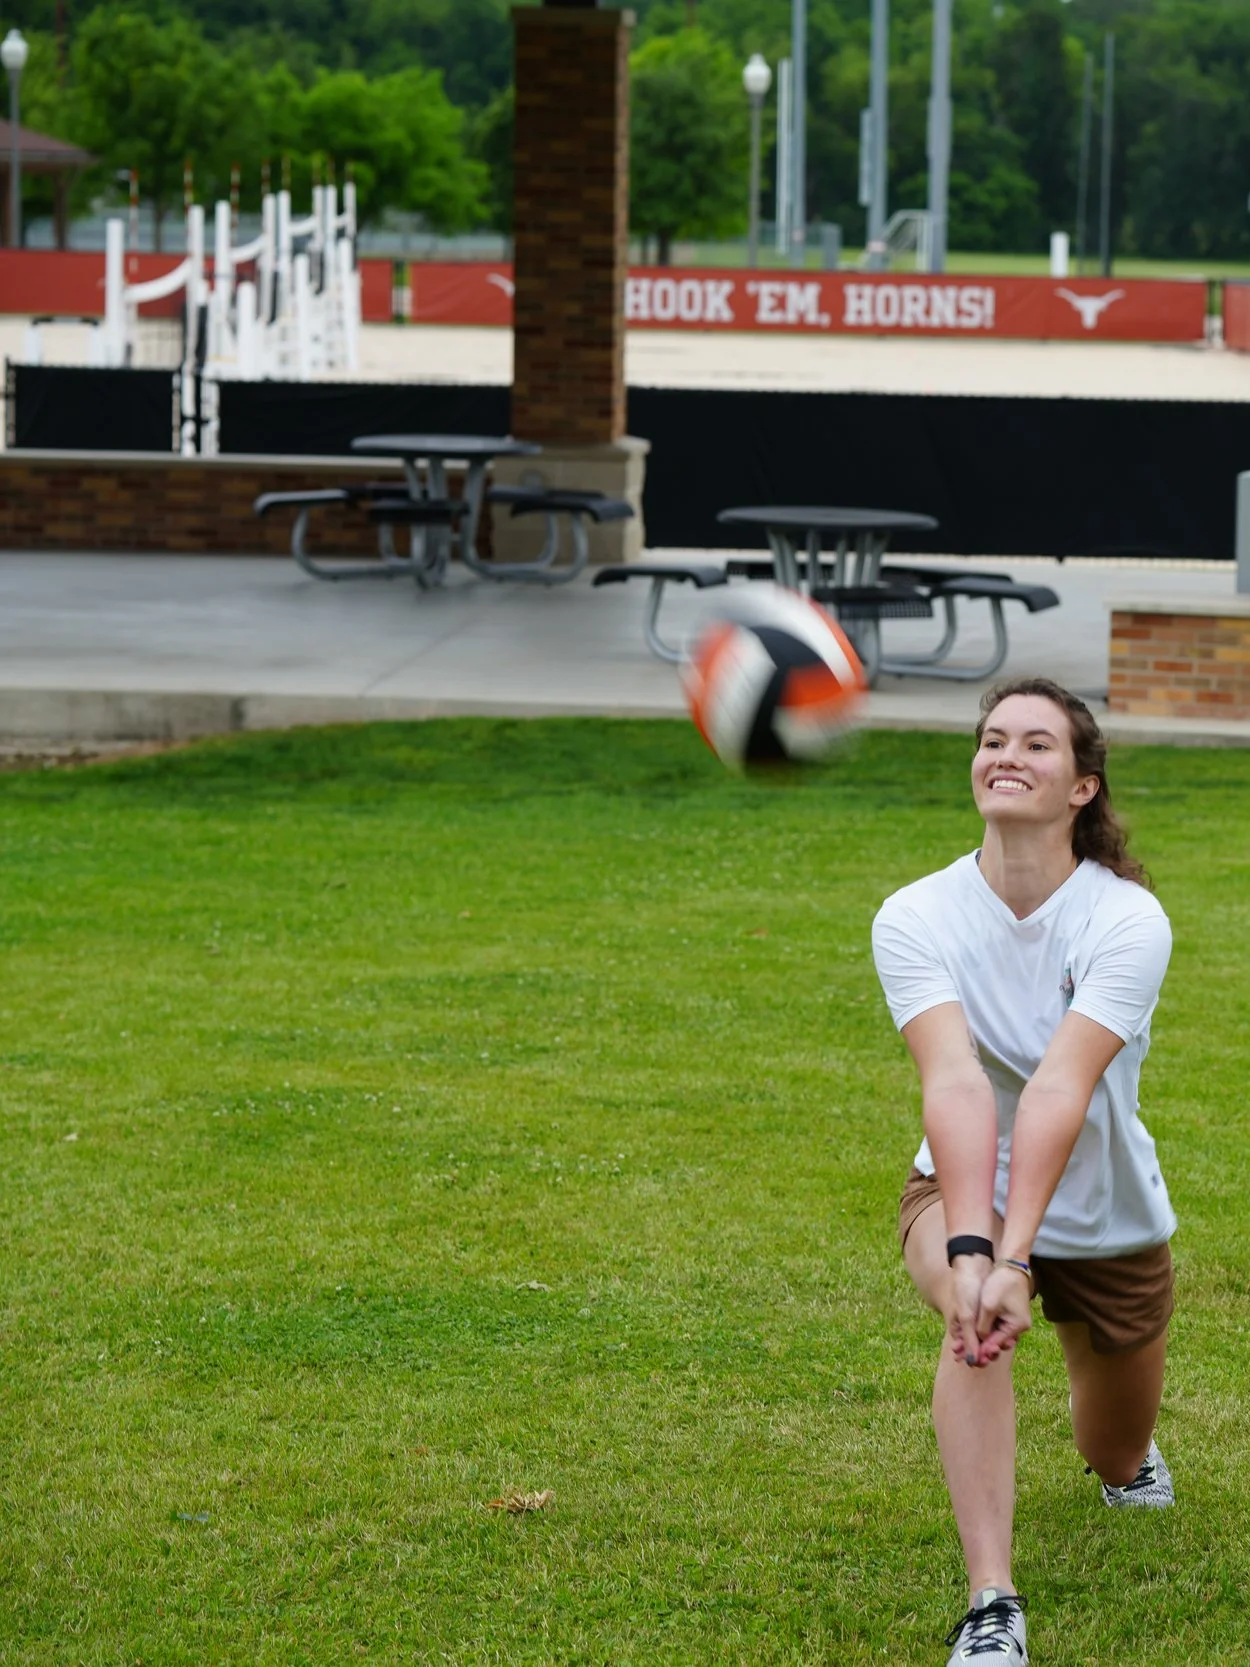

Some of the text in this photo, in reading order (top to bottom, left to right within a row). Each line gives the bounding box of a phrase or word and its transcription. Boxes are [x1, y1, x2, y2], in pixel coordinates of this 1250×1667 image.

[624, 277, 995, 329] HOOK 'EM, HORNS!
